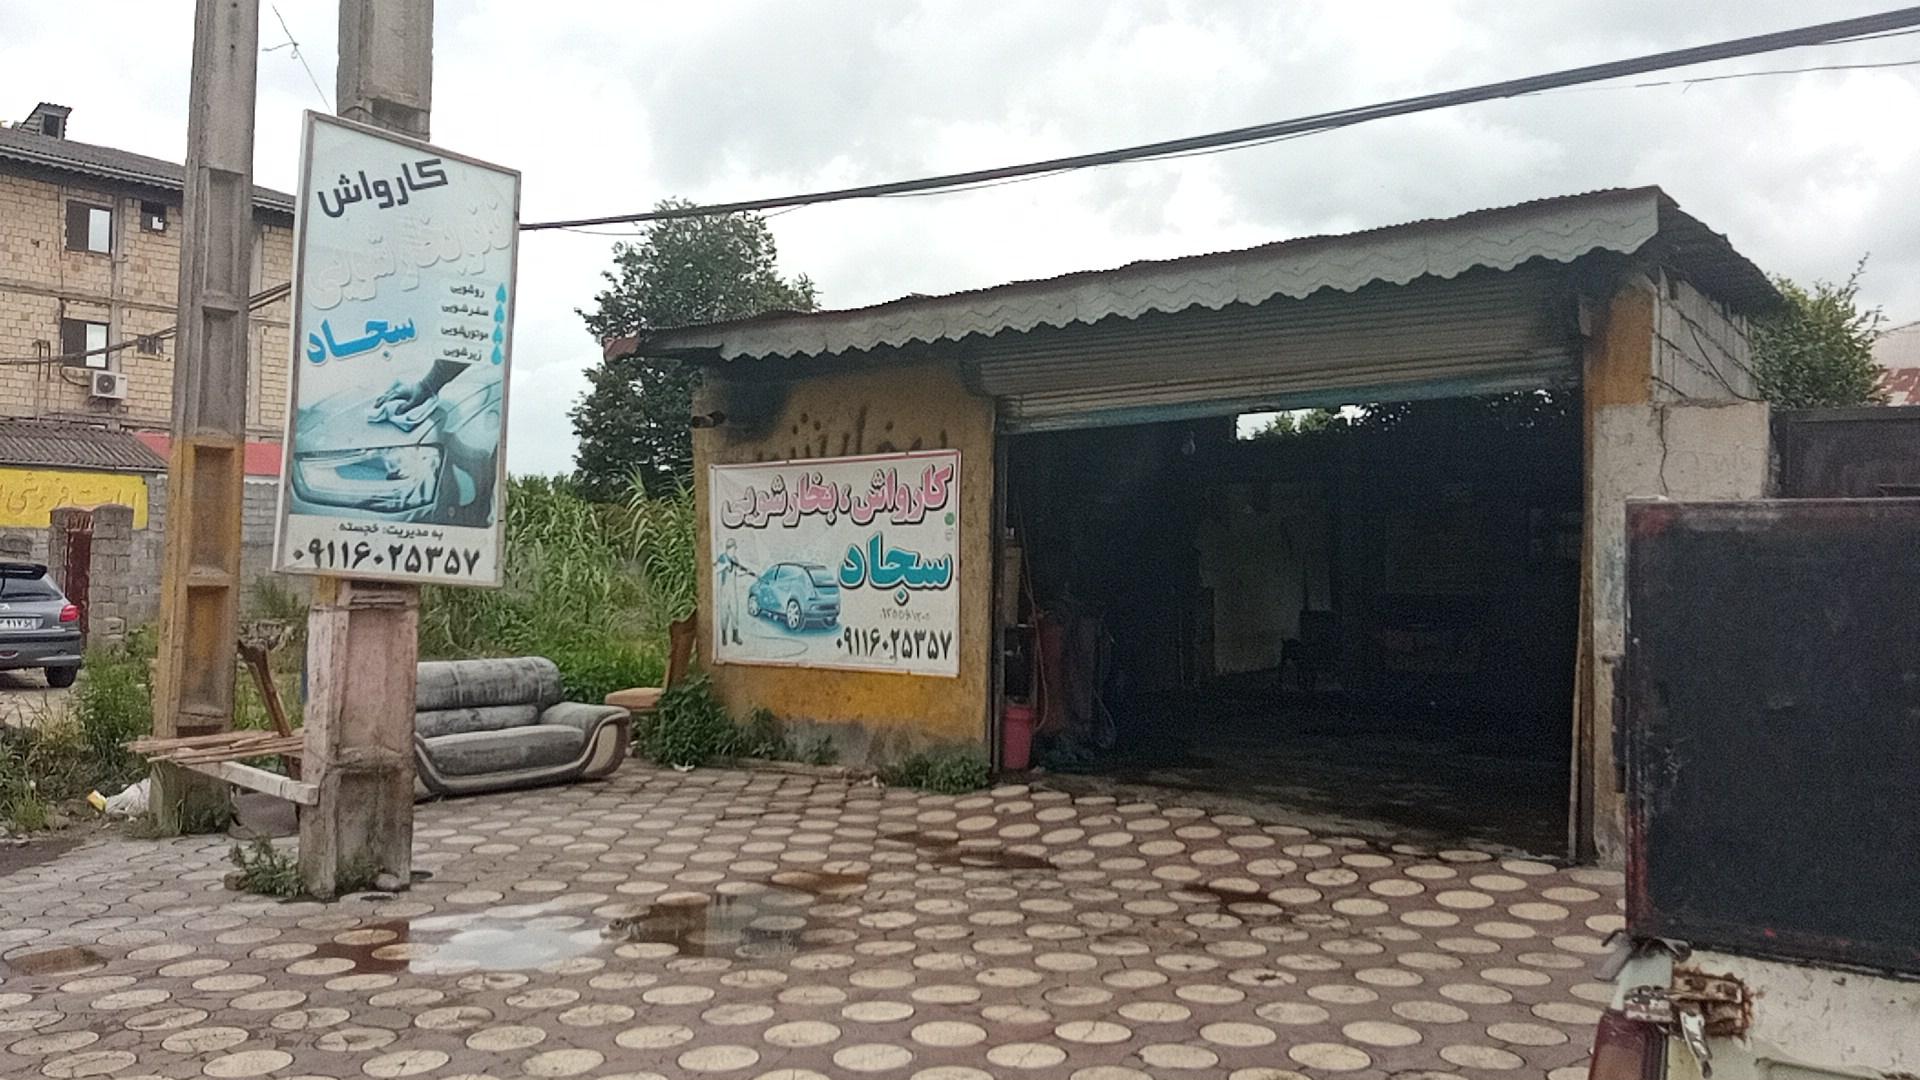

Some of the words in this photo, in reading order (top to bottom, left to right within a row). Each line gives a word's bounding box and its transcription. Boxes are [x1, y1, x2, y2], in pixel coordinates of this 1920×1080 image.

[317, 158, 449, 218] کارواش
[306, 317, 417, 364] سجاد
[431, 529, 444, 541] به
[292, 537, 481, 577] ۰۹۱۱۶۰۲۵۳۵۷
[838, 530, 954, 607] سجاد
[836, 626, 953, 660] ۰۹۱۱۶۰۲۵۳۵۷
